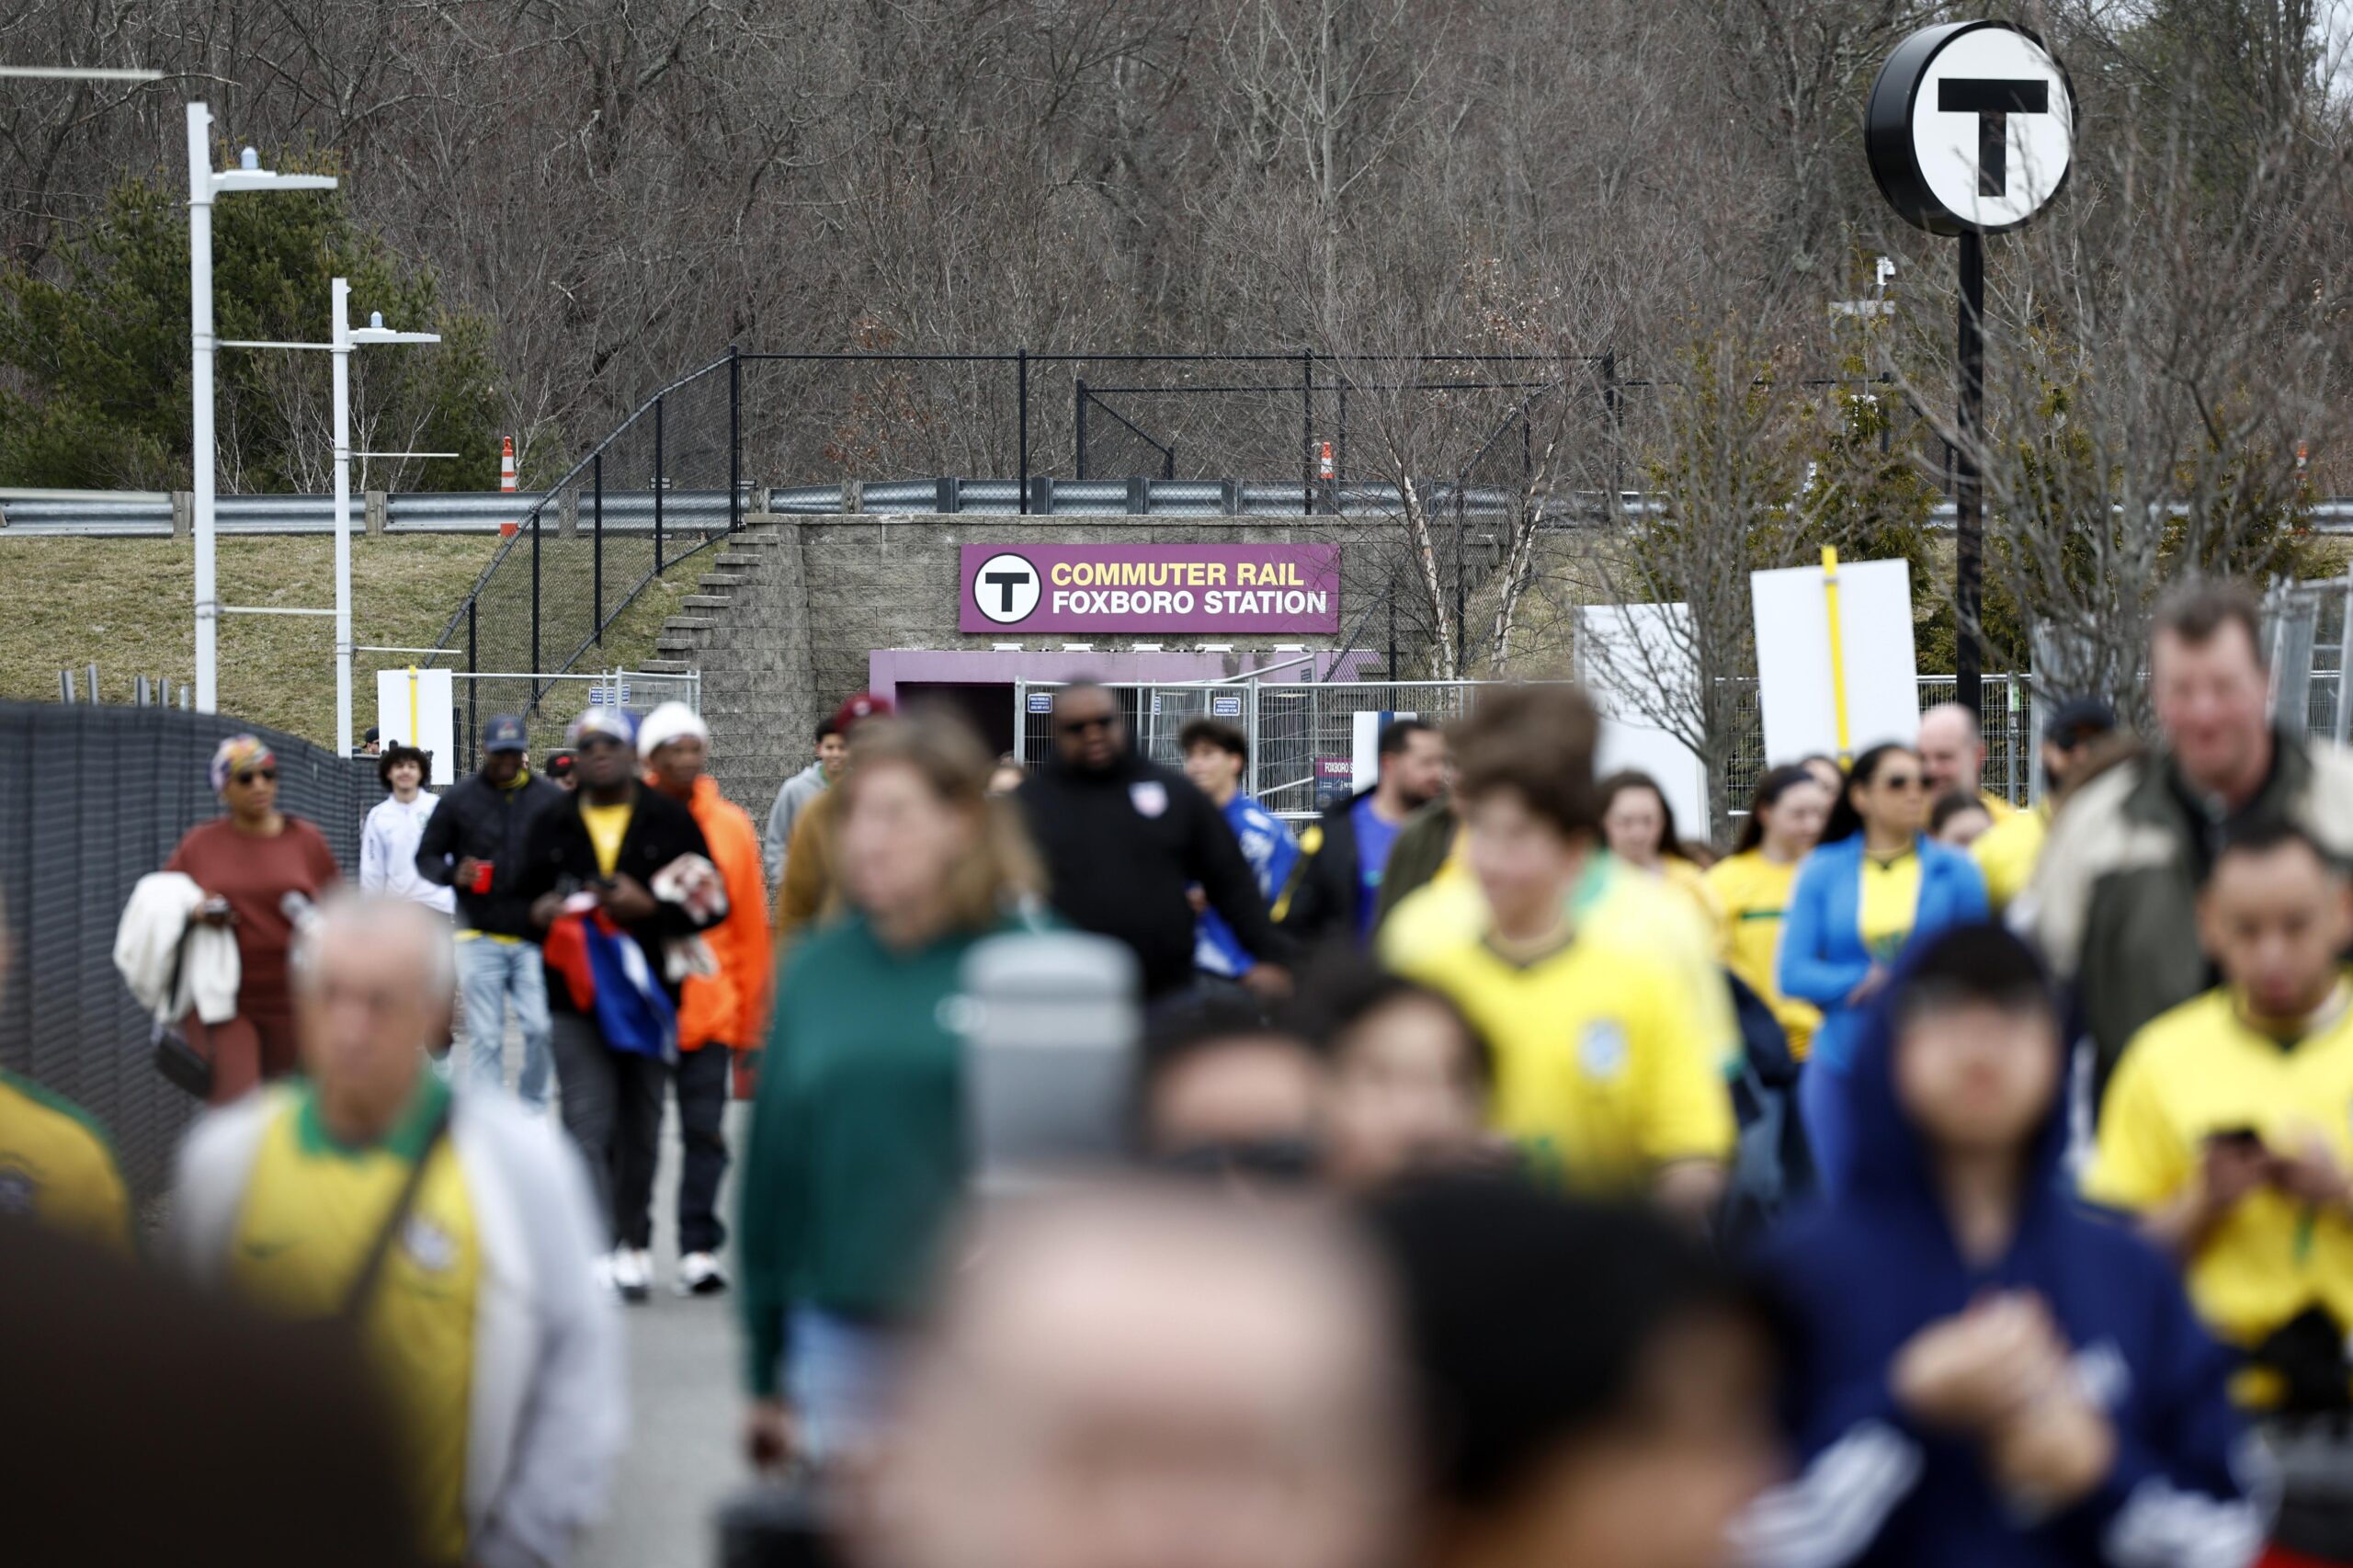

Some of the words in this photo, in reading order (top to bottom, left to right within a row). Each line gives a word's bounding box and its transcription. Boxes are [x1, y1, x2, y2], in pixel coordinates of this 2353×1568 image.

[1938, 78, 2048, 197] T
[1051, 562, 1226, 586] COMMUTER
[1237, 562, 1304, 585] RAIL
[985, 573, 1029, 612] T
[1052, 590, 1194, 614] FOXBORO
[1204, 590, 1326, 614] STATION
[1324, 762, 1348, 773] FOXBORO
